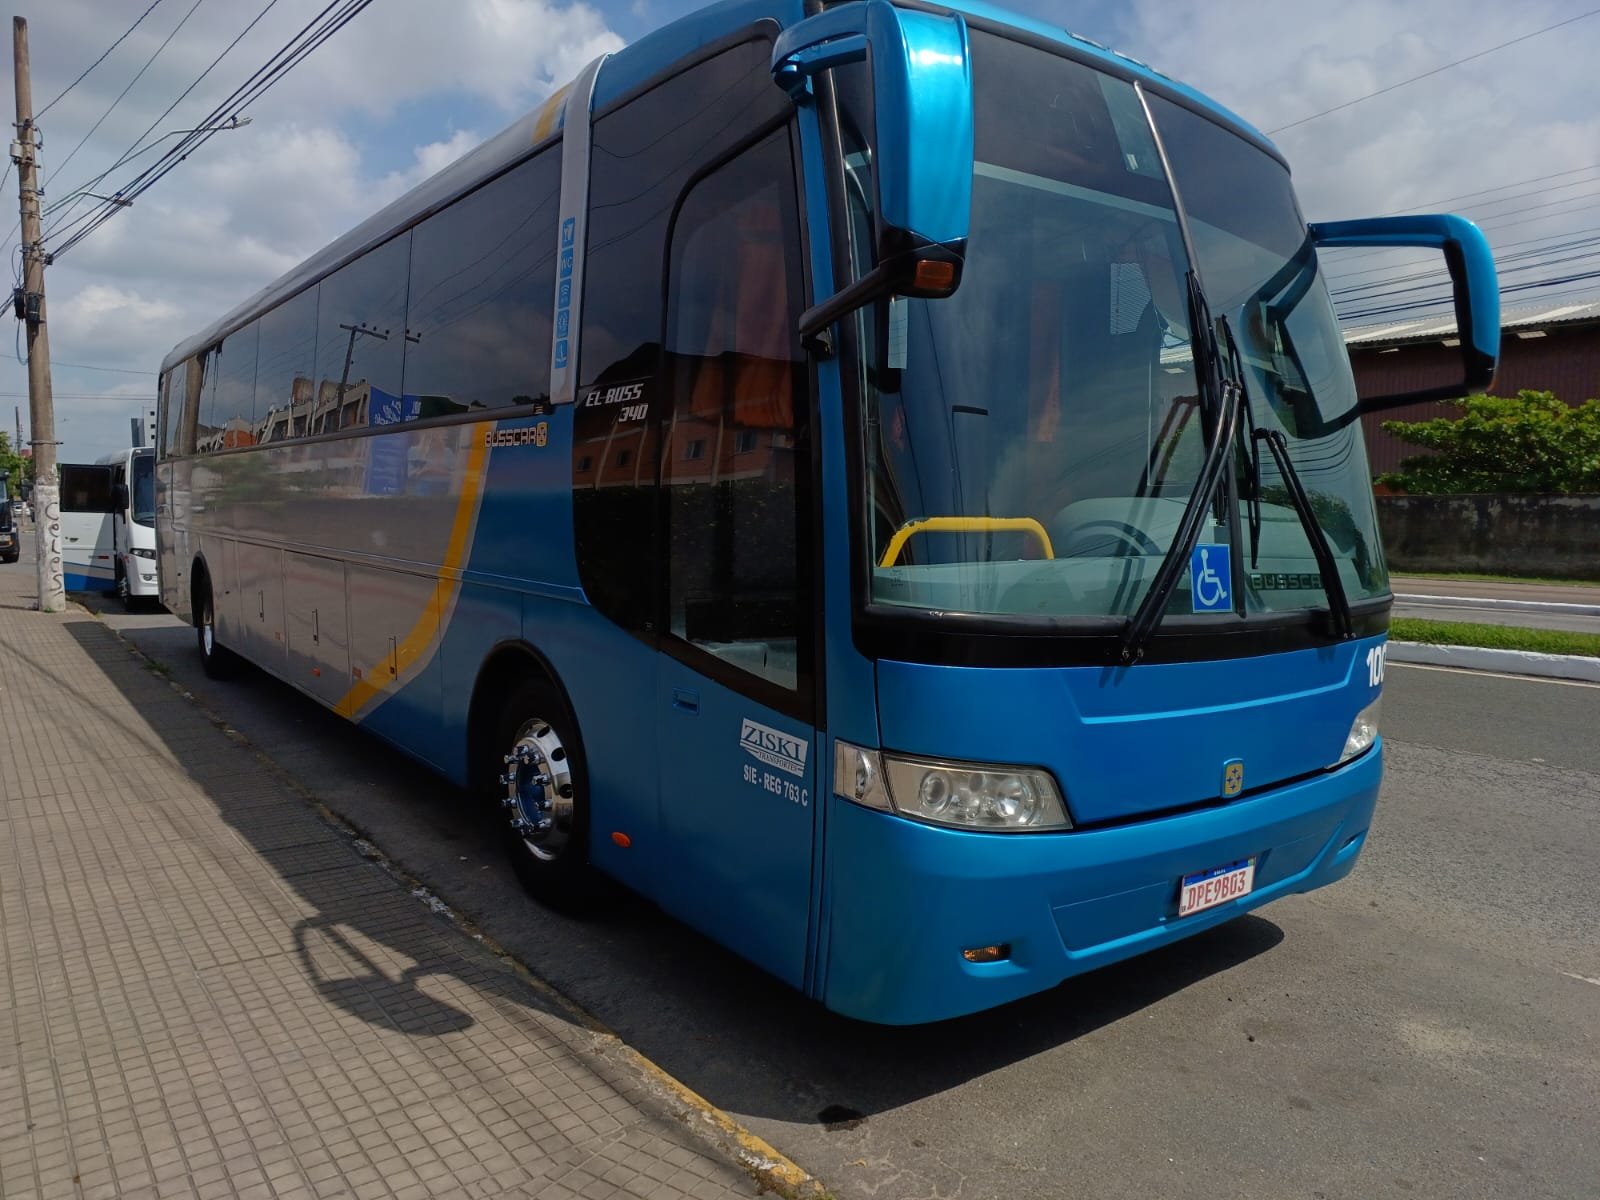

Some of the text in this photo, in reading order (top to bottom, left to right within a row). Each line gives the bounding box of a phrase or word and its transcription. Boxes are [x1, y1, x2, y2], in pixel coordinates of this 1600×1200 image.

[584, 383, 645, 407] EL-BUSS
[618, 402, 649, 423] 340
[484, 427, 537, 448] BUSSCAR
[1250, 574, 1323, 590] BUSSCA
[742, 725, 801, 761] ZISKI
[743, 763, 758, 785] SIE
[763, 772, 782, 795] REG
[783, 780, 800, 803] 763
[801, 788, 809, 807] C
[1187, 870, 1247, 911] DPE9B03
